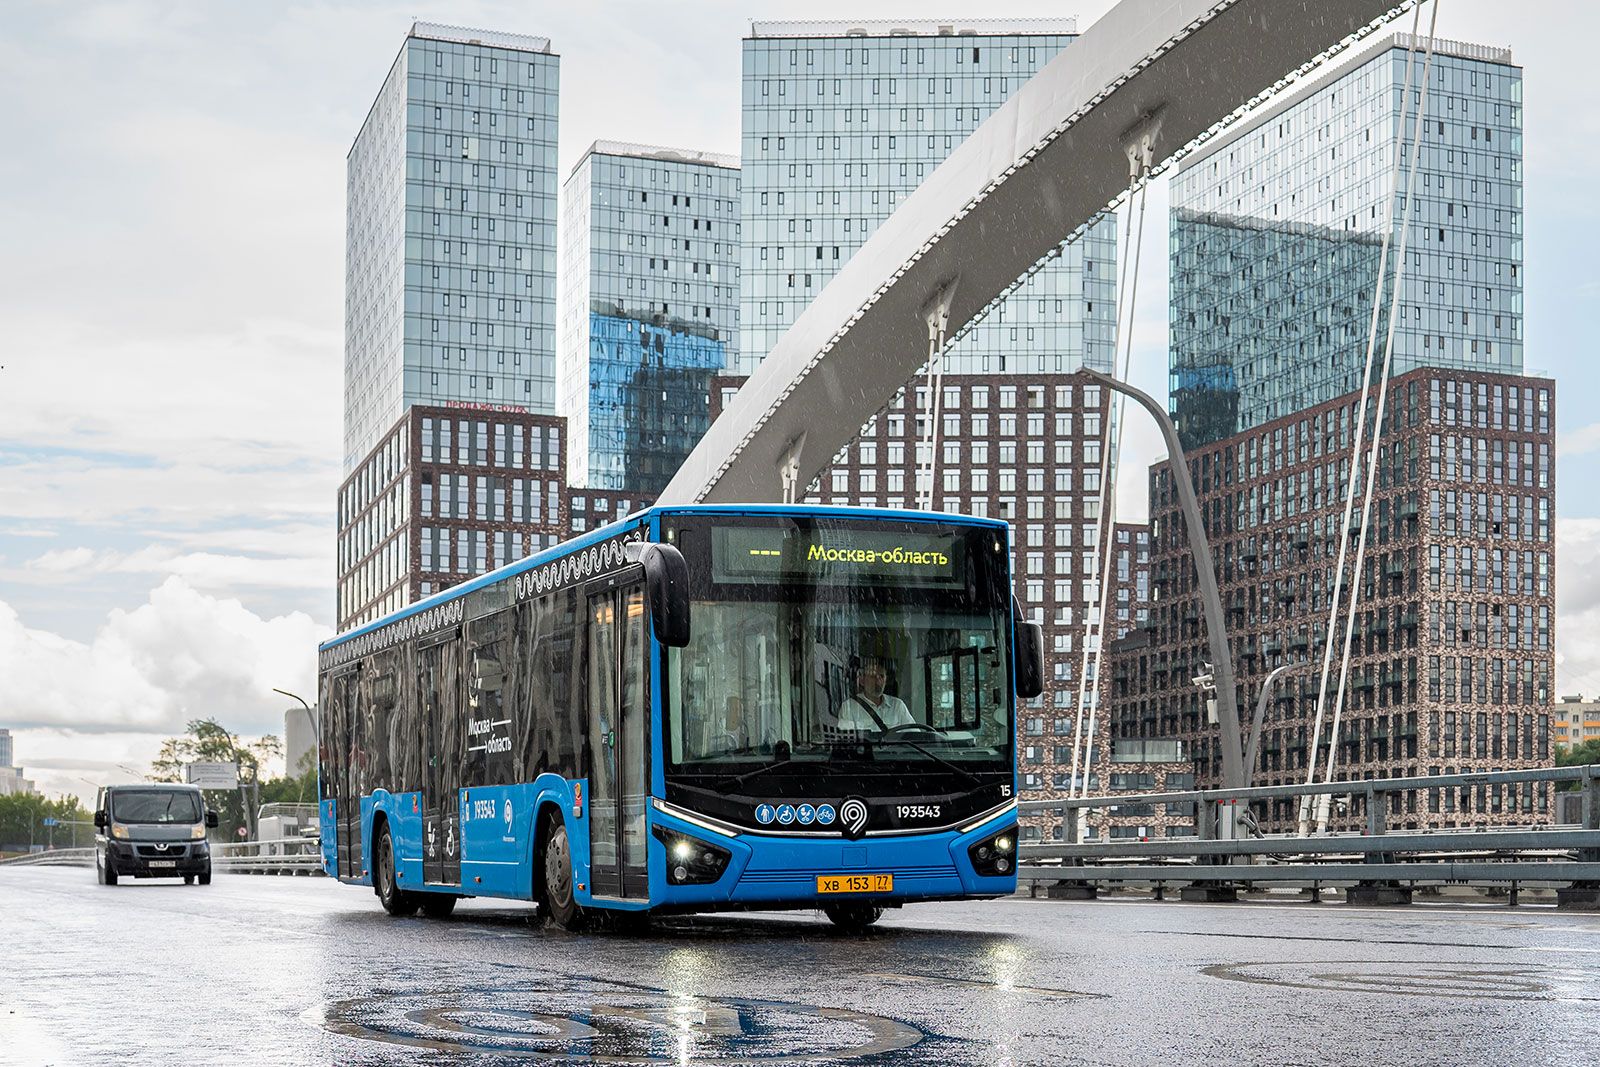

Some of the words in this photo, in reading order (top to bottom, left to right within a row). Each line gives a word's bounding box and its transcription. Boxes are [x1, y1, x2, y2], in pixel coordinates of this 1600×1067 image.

[808, 544, 948, 565] Москва-область
[468, 718, 490, 736] Москва
[487, 733, 512, 754] область
[1000, 784, 1011, 797] 15
[474, 799, 496, 819] 193543
[896, 805, 940, 818] 193543
[846, 877, 869, 890] 153
[876, 876, 888, 886] 77
